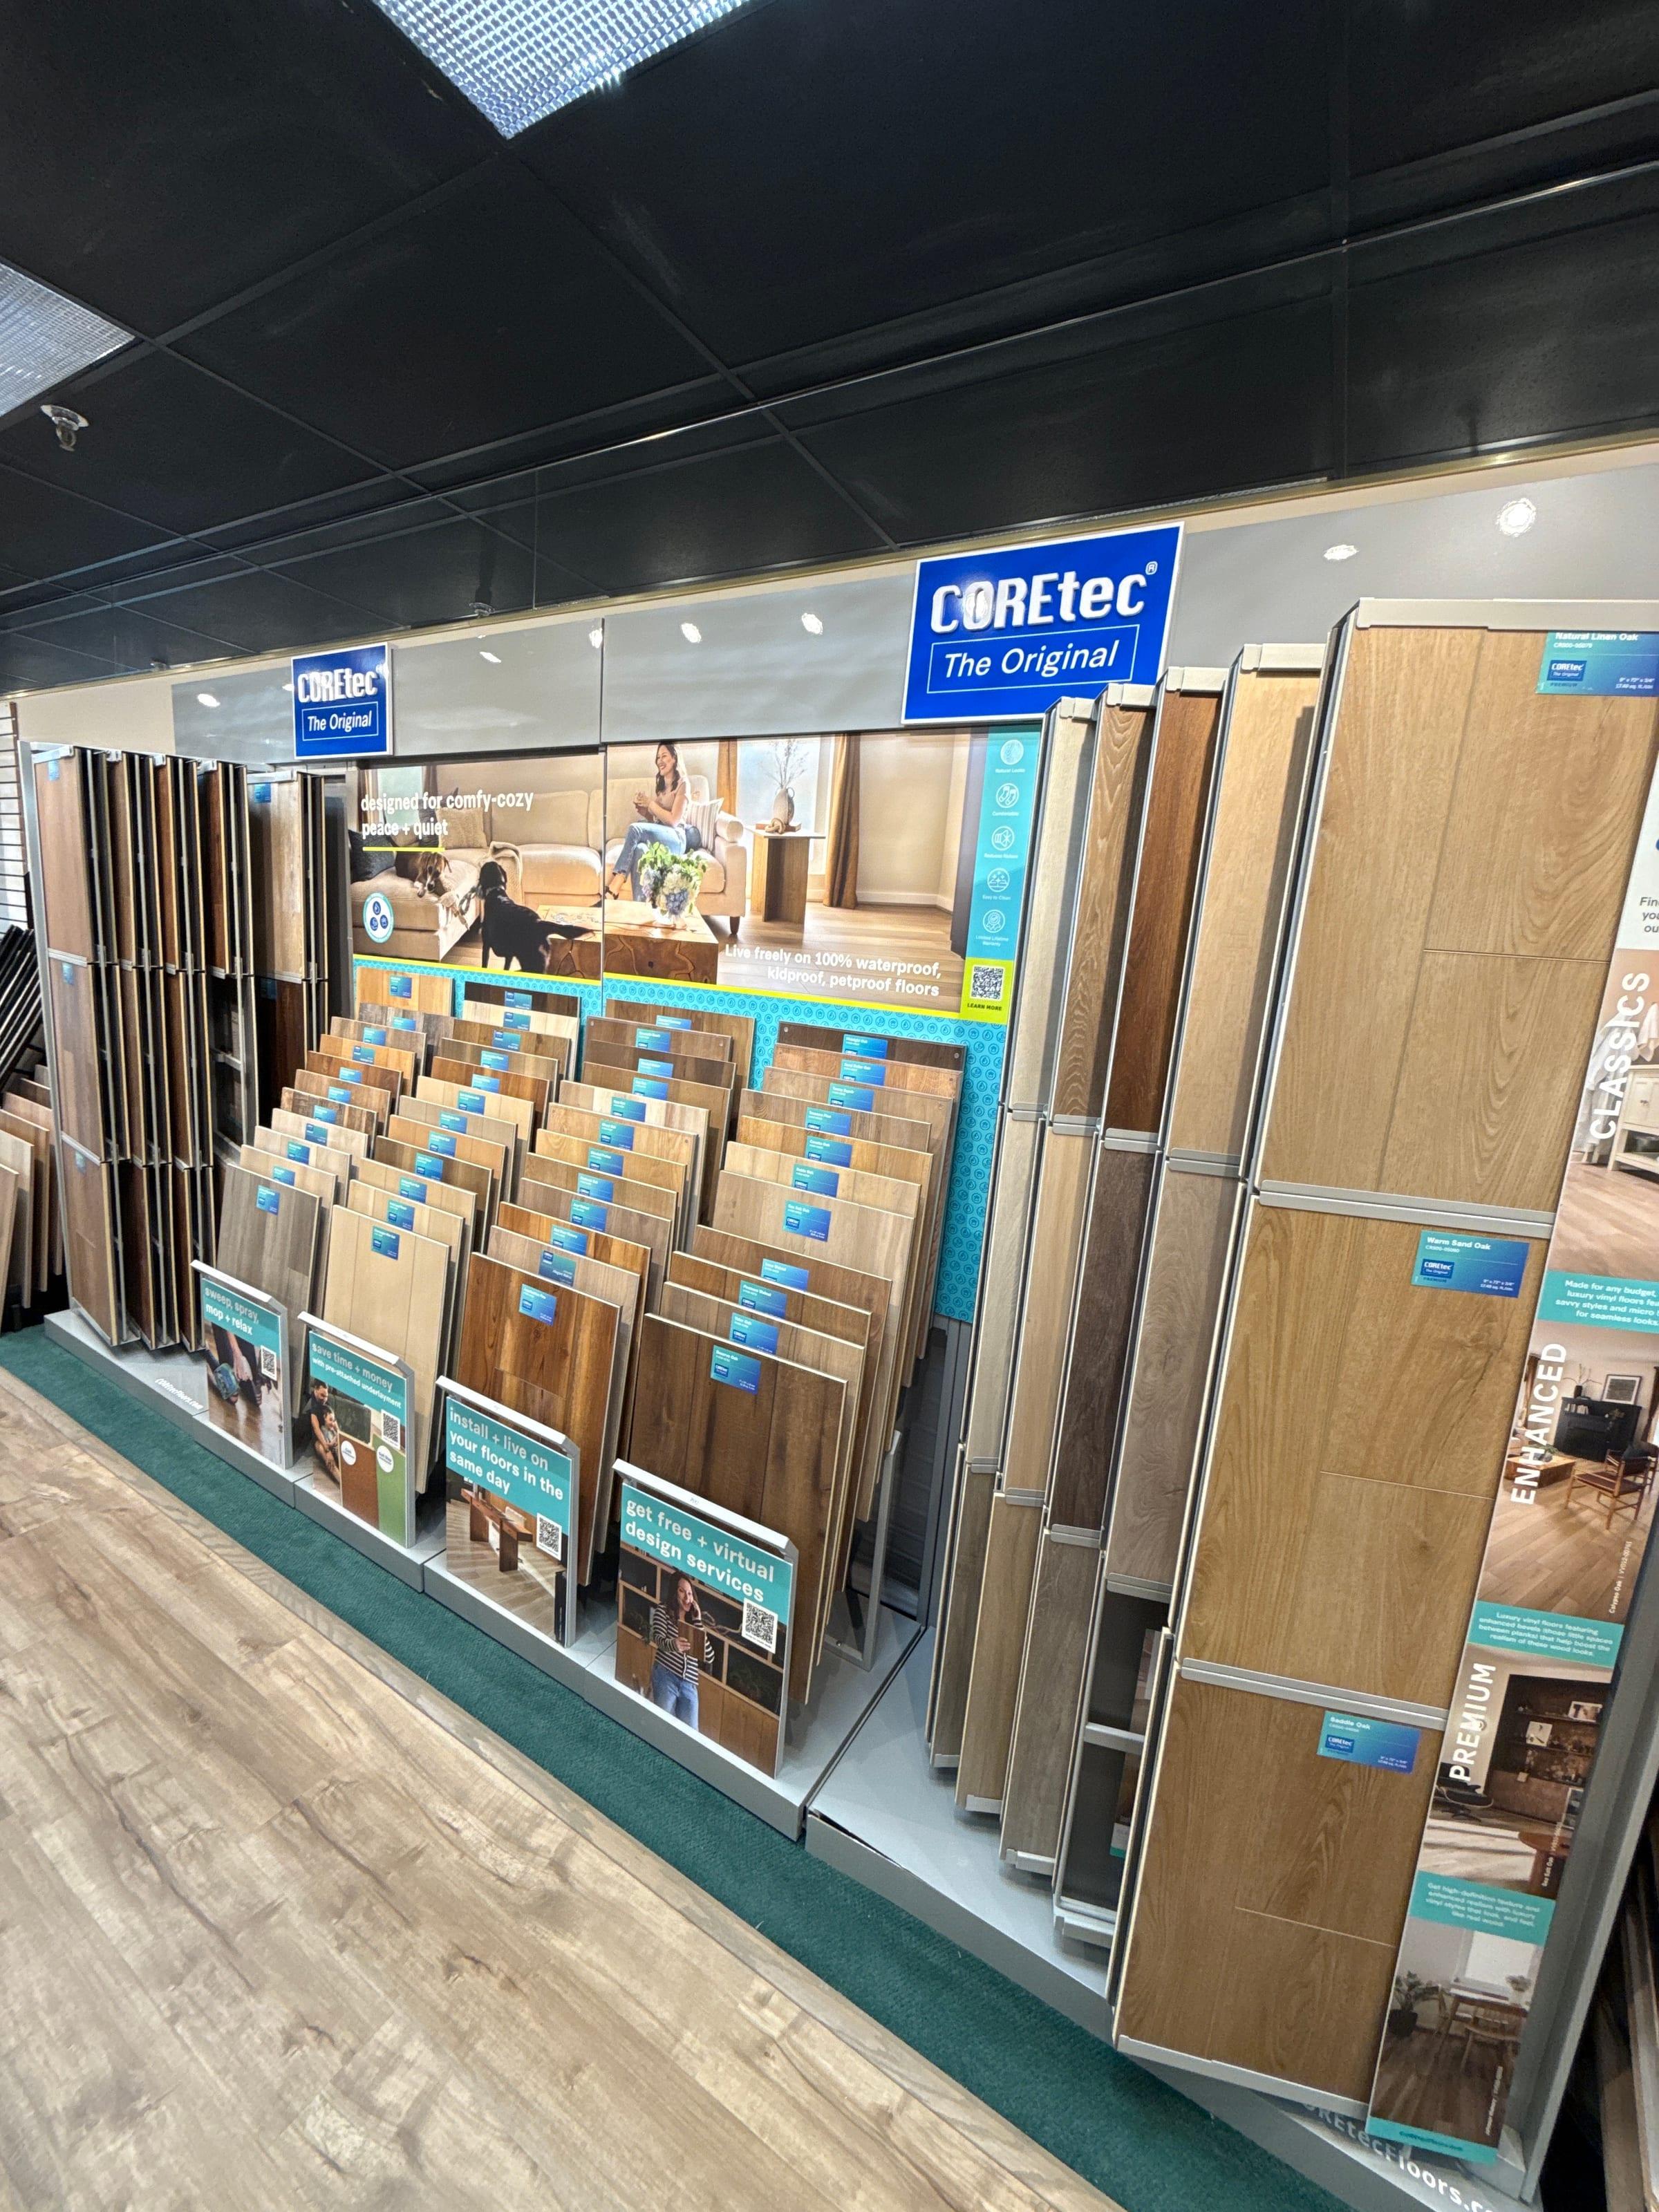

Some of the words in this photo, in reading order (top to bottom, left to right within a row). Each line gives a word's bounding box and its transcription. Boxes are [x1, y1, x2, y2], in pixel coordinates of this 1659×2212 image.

[1555, 632, 1589, 641] Natural
[1591, 632, 1617, 641] Linen
[1619, 633, 1639, 641] Oak
[945, 653, 992, 679] The
[1002, 639, 1120, 678] Original
[308, 715, 326, 732] The
[330, 710, 373, 733] Original
[361, 793, 419, 814] designed
[422, 790, 443, 809] for
[446, 789, 534, 812] comfy-cozy
[362, 821, 400, 840] peace
[402, 822, 410, 836] +
[413, 817, 449, 841] quiet
[725, 944, 751, 959] Live
[755, 946, 791, 966] freely
[794, 953, 812, 964] on
[814, 952, 853, 969] 100%
[856, 958, 941, 980] waterproof,
[767, 967, 827, 987] kidproof,
[830, 973, 892, 994] petproof
[896, 981, 940, 997] floors
[1590, 971, 1650, 1140] CLASSICS
[1427, 1237, 1450, 1246] Warm
[1452, 1239, 1472, 1248] Sand
[1474, 1242, 1492, 1250] Oak
[1565, 1280, 1589, 1290] Made
[1591, 1282, 1604, 1291] for
[1567, 1290, 1594, 1300] luxury
[1596, 1293, 1616, 1302] vinyl
[1618, 1295, 1644, 1306] floors
[205, 1287, 233, 1311] sweep,
[234, 1300, 259, 1324] spray,
[206, 1304, 225, 1321] mop
[225, 1314, 231, 1322] +
[232, 1317, 253, 1335] relax
[1555, 1299, 1580, 1309] savvy
[1582, 1302, 1609, 1311] styles
[1609, 1304, 1627, 1313] and
[1629, 1308, 1655, 1316] micro
[1576, 1309, 1589, 1318] for
[1590, 1313, 1631, 1323] seamless
[312, 1342, 332, 1359] save
[333, 1351, 353, 1370] time
[362, 1367, 393, 1393] money
[312, 1357, 325, 1368] with
[325, 1364, 361, 1387] pre-attached
[361, 1382, 402, 1409] underlayment
[1510, 1342, 1567, 1505] ENHANCED
[450, 1406, 489, 1439] install
[492, 1434, 500, 1445] +
[503, 1436, 527, 1459] live
[531, 1453, 548, 1472] on
[449, 1451, 483, 1477] same
[486, 1470, 510, 1495] day
[450, 1431, 478, 1454] your
[481, 1445, 520, 1477] floors
[523, 1466, 536, 1486] in
[539, 1477, 563, 1501] the
[626, 1499, 653, 1522] get
[657, 1511, 692, 1541] free
[697, 1535, 708, 1548] +
[713, 1541, 775, 1583] virtual
[625, 1521, 682, 1561] design
[686, 1553, 765, 1603] services
[1479, 1617, 1517, 1629] enhanced
[1479, 1624, 1510, 1635] between
[1539, 1633, 1555, 1642] that
[1556, 1637, 1573, 1647] help
[1496, 1611, 1521, 1623] Luxury
[1522, 1615, 1541, 1624] vinyl
[1541, 1620, 1564, 1629] floors
[1565, 1622, 1599, 1637] featuring
[1518, 1638, 1527, 1646] of
[1550, 1644, 1571, 1653] wood
[1356, 1721, 1371, 1730] Oak
[1449, 1662, 1497, 1782] PREMIUM
[1427, 1882, 1441, 1891] Get
